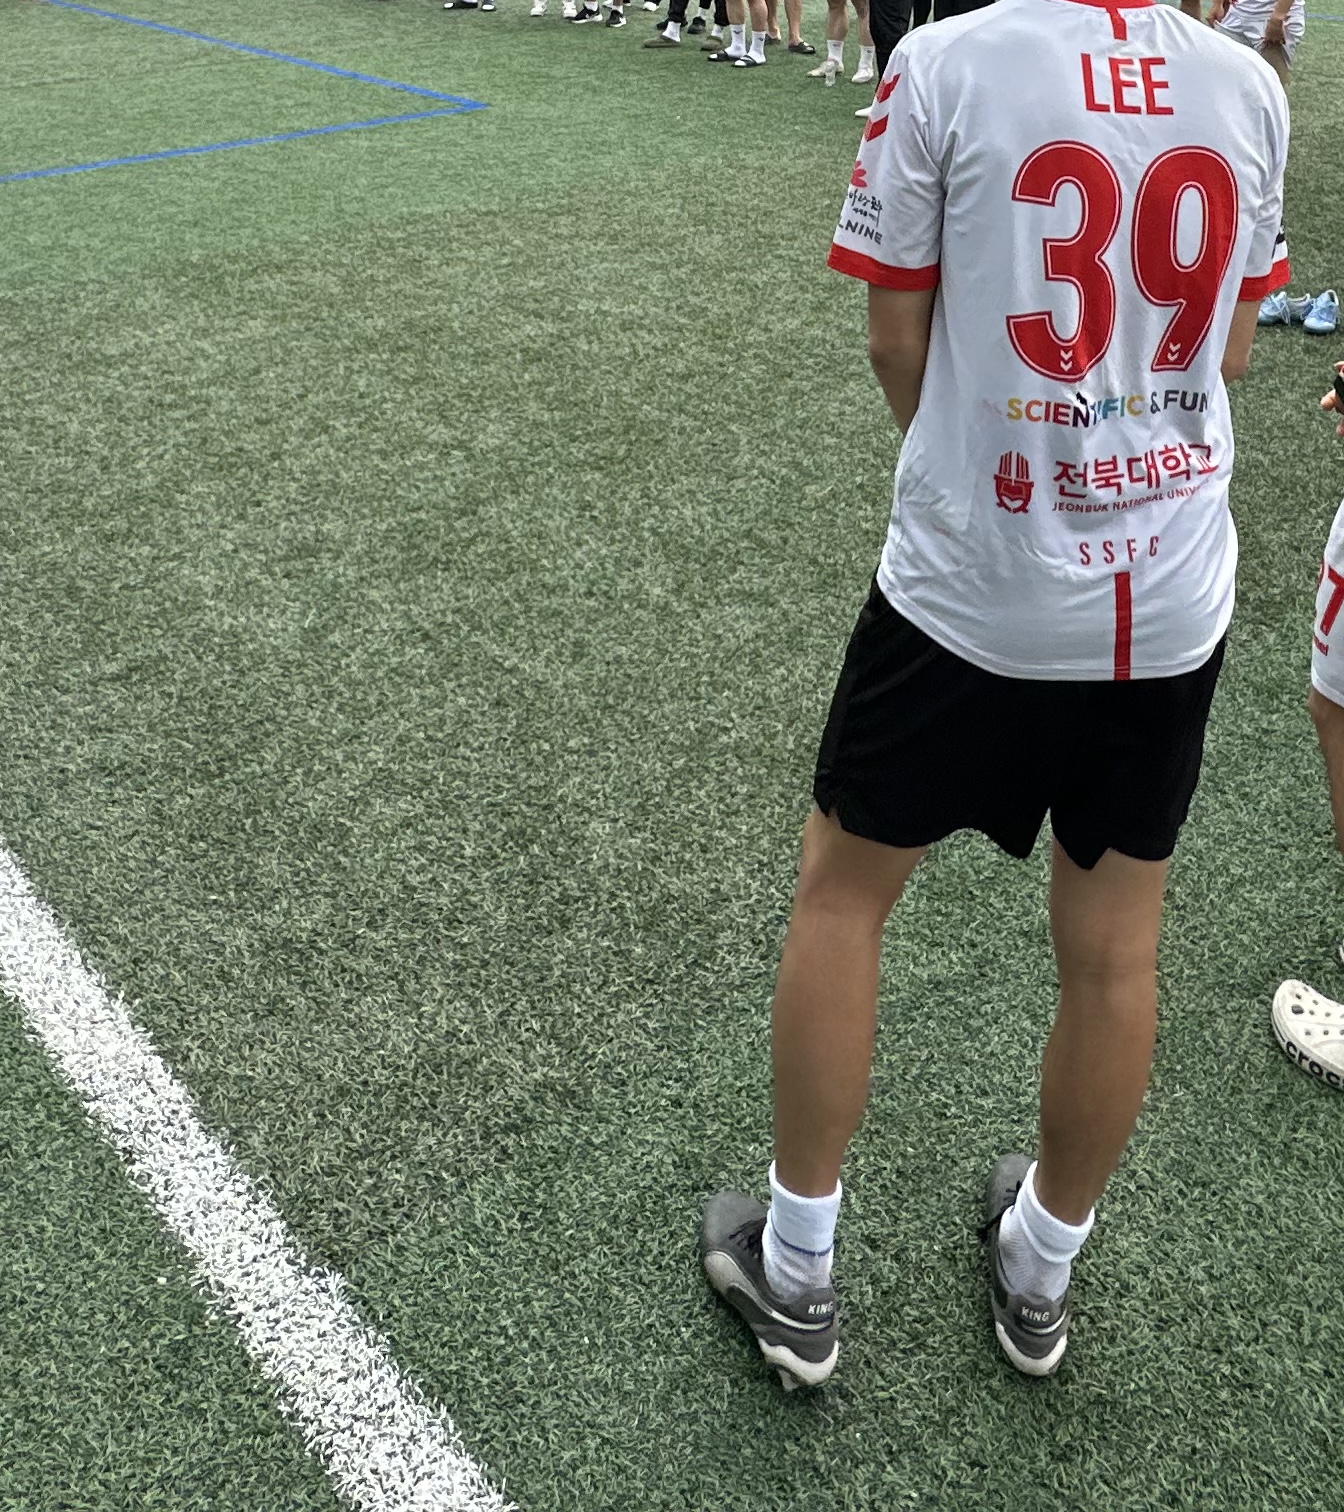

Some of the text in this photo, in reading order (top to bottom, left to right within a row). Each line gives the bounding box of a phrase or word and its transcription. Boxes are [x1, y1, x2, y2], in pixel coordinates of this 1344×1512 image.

[1079, 52, 1174, 116] LEE
[1006, 140, 1238, 383] 39
[1053, 442, 1219, 499] 전북대학교
[1021, 1306, 1050, 1322] KING
